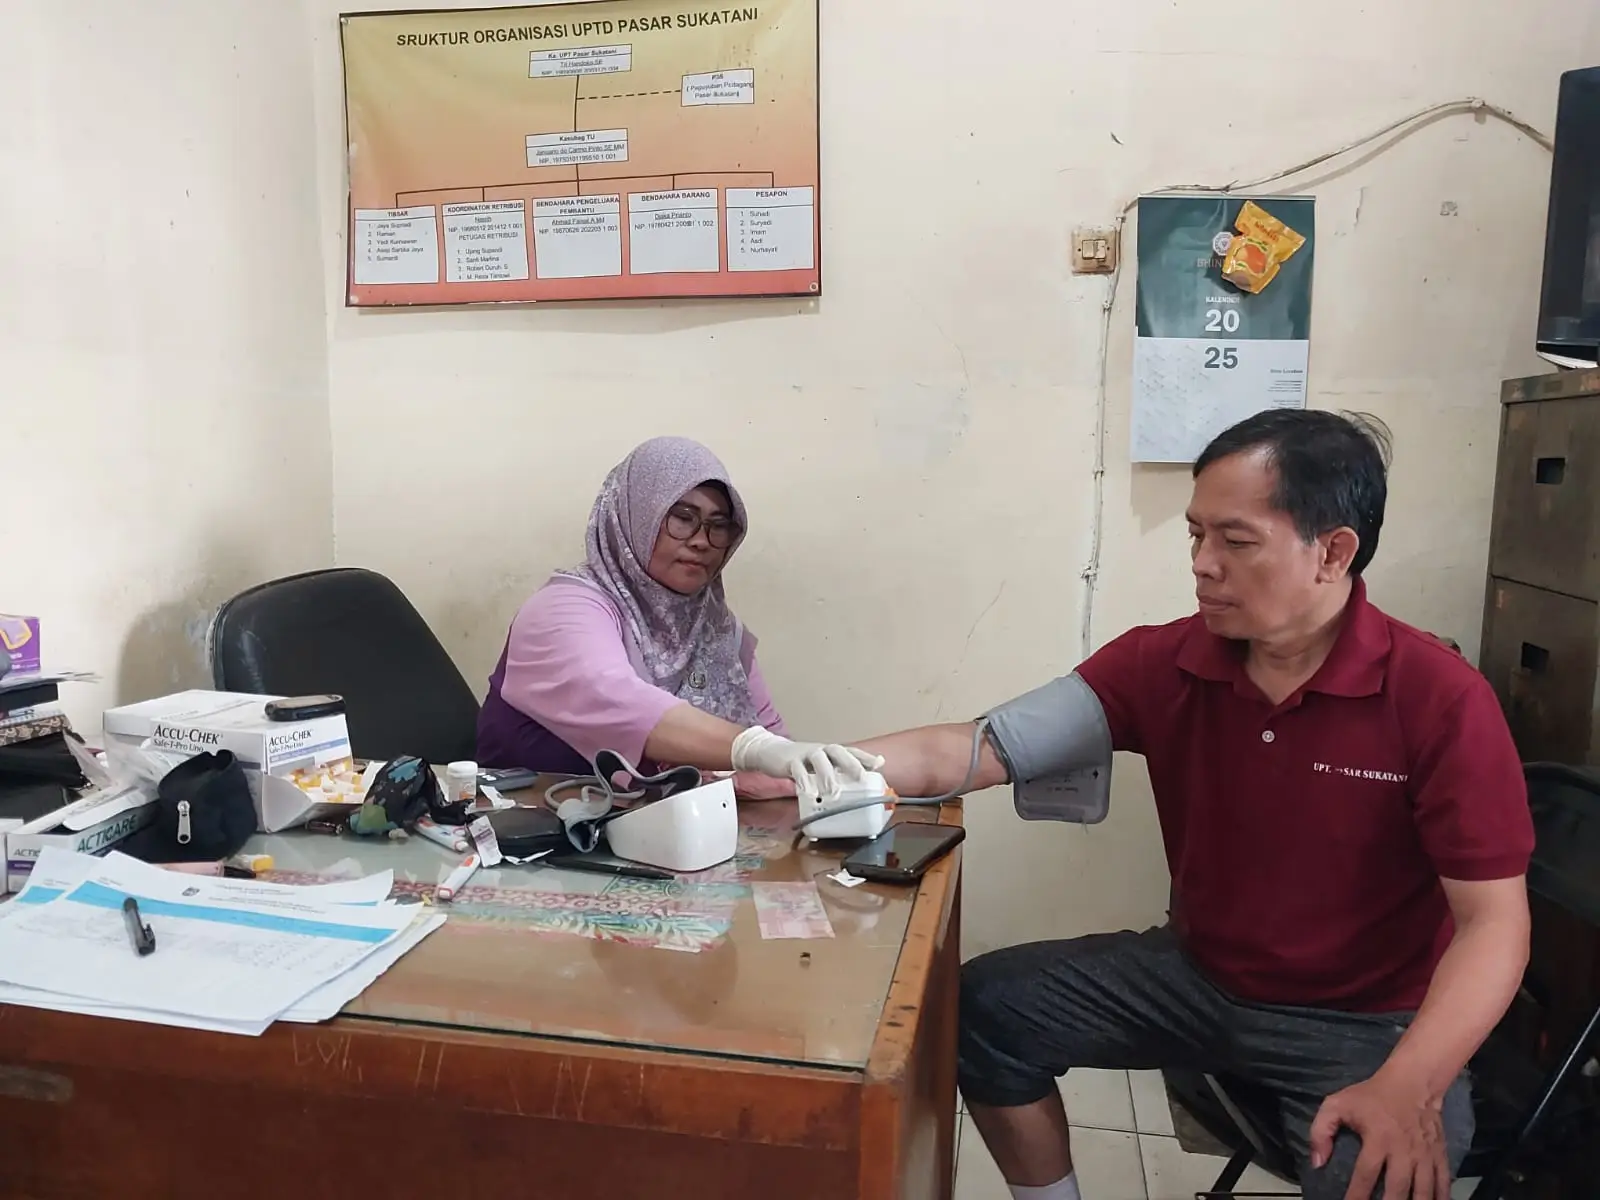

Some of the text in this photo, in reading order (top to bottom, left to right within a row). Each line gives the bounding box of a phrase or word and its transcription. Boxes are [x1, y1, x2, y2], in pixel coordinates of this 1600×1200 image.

[397, 8, 758, 46] SRUKTUR ORGANISASI UPTD PASAR SUKATANI
[536, 199, 575, 208] BENDAHARA
[641, 191, 711, 202] BENDAHARA BARANG
[447, 202, 523, 213] KOORDINATOR RETRIBUSI
[459, 232, 518, 241] PETUGAS RETRIBUSI
[1205, 309, 1240, 332] 20
[1204, 346, 1238, 369] 25
[1313, 762, 1332, 773] UPT.
[1362, 770, 1408, 782] SUKATANI
[76, 814, 139, 852] ACTICARE
